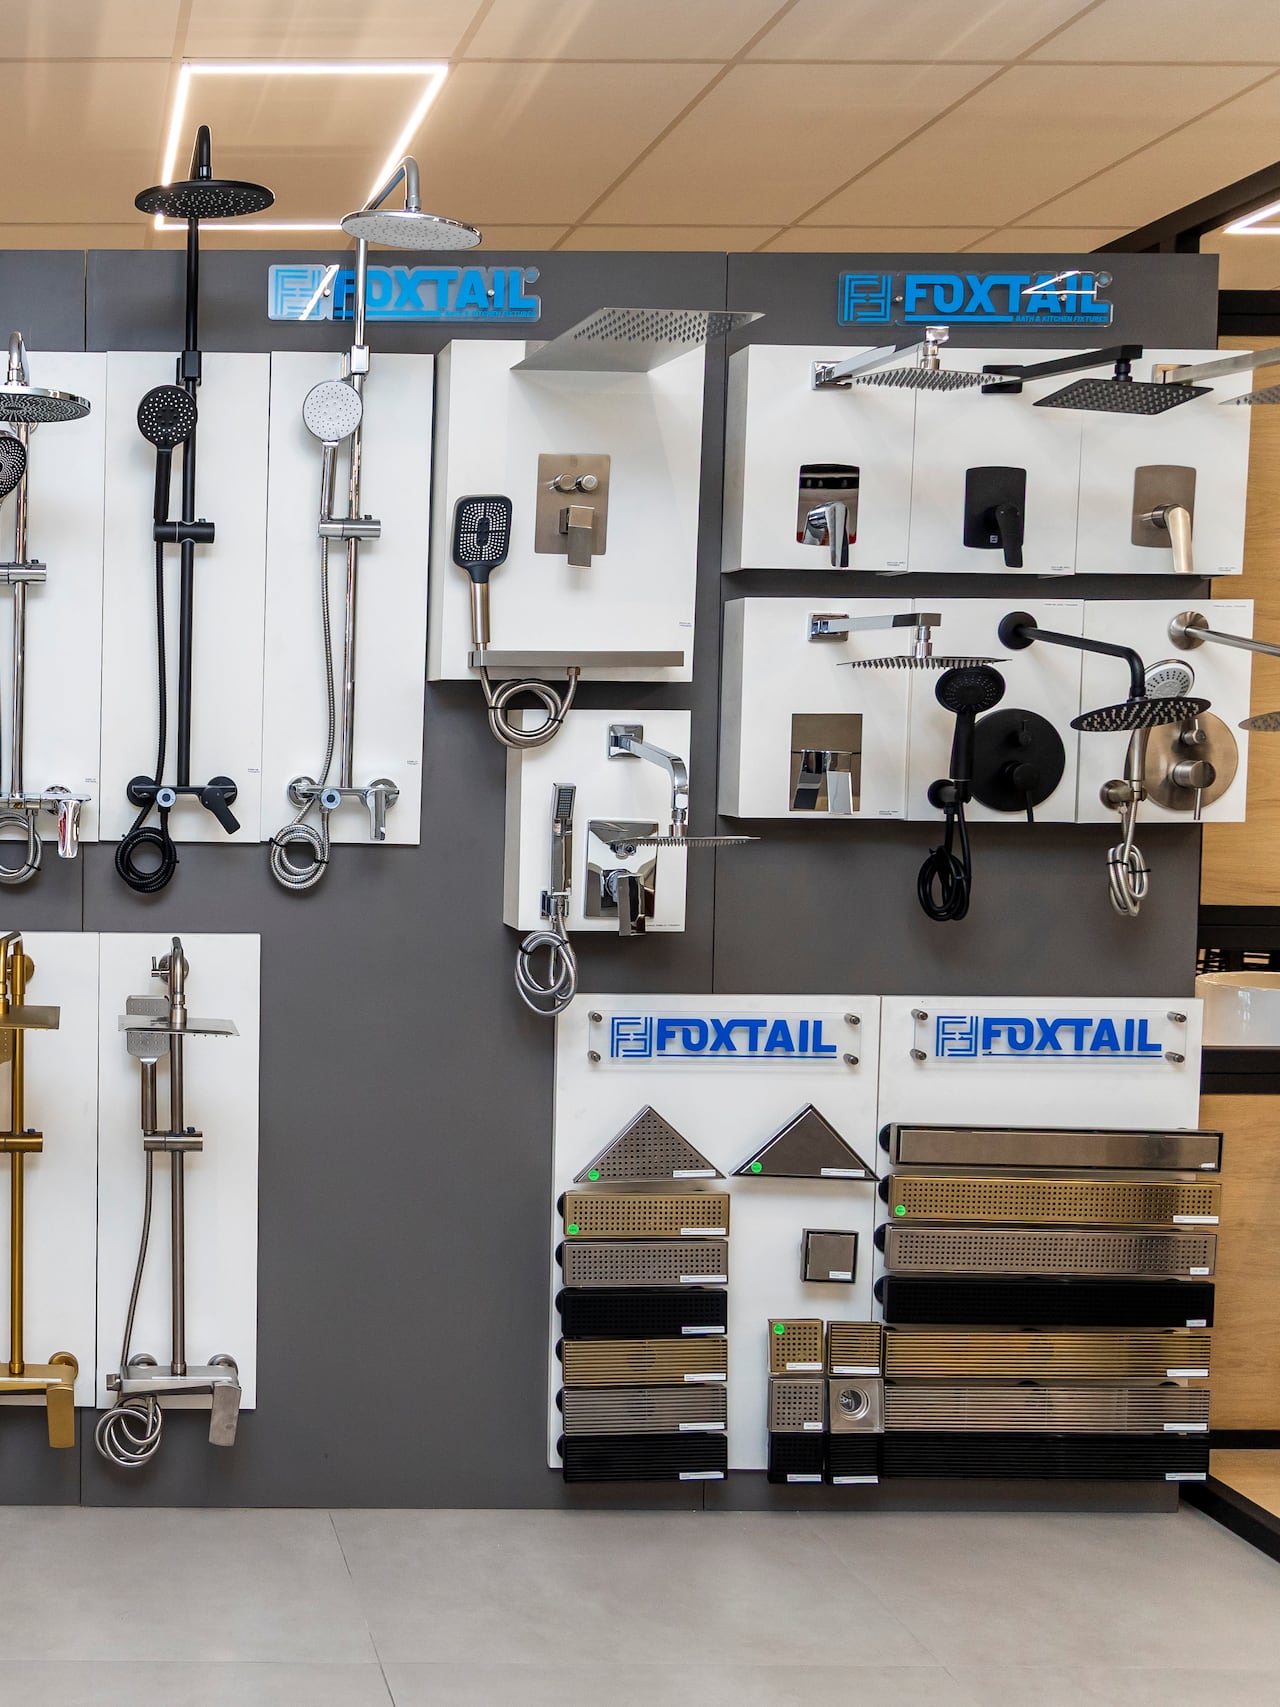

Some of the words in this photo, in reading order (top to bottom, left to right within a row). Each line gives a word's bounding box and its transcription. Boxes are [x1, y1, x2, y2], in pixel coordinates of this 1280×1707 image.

[333, 269, 536, 309] FOXTAIL
[904, 273, 1109, 313] FOXTAIL
[657, 1018, 837, 1052] FOXTAIL
[983, 1017, 1162, 1051] FOXTAIL
